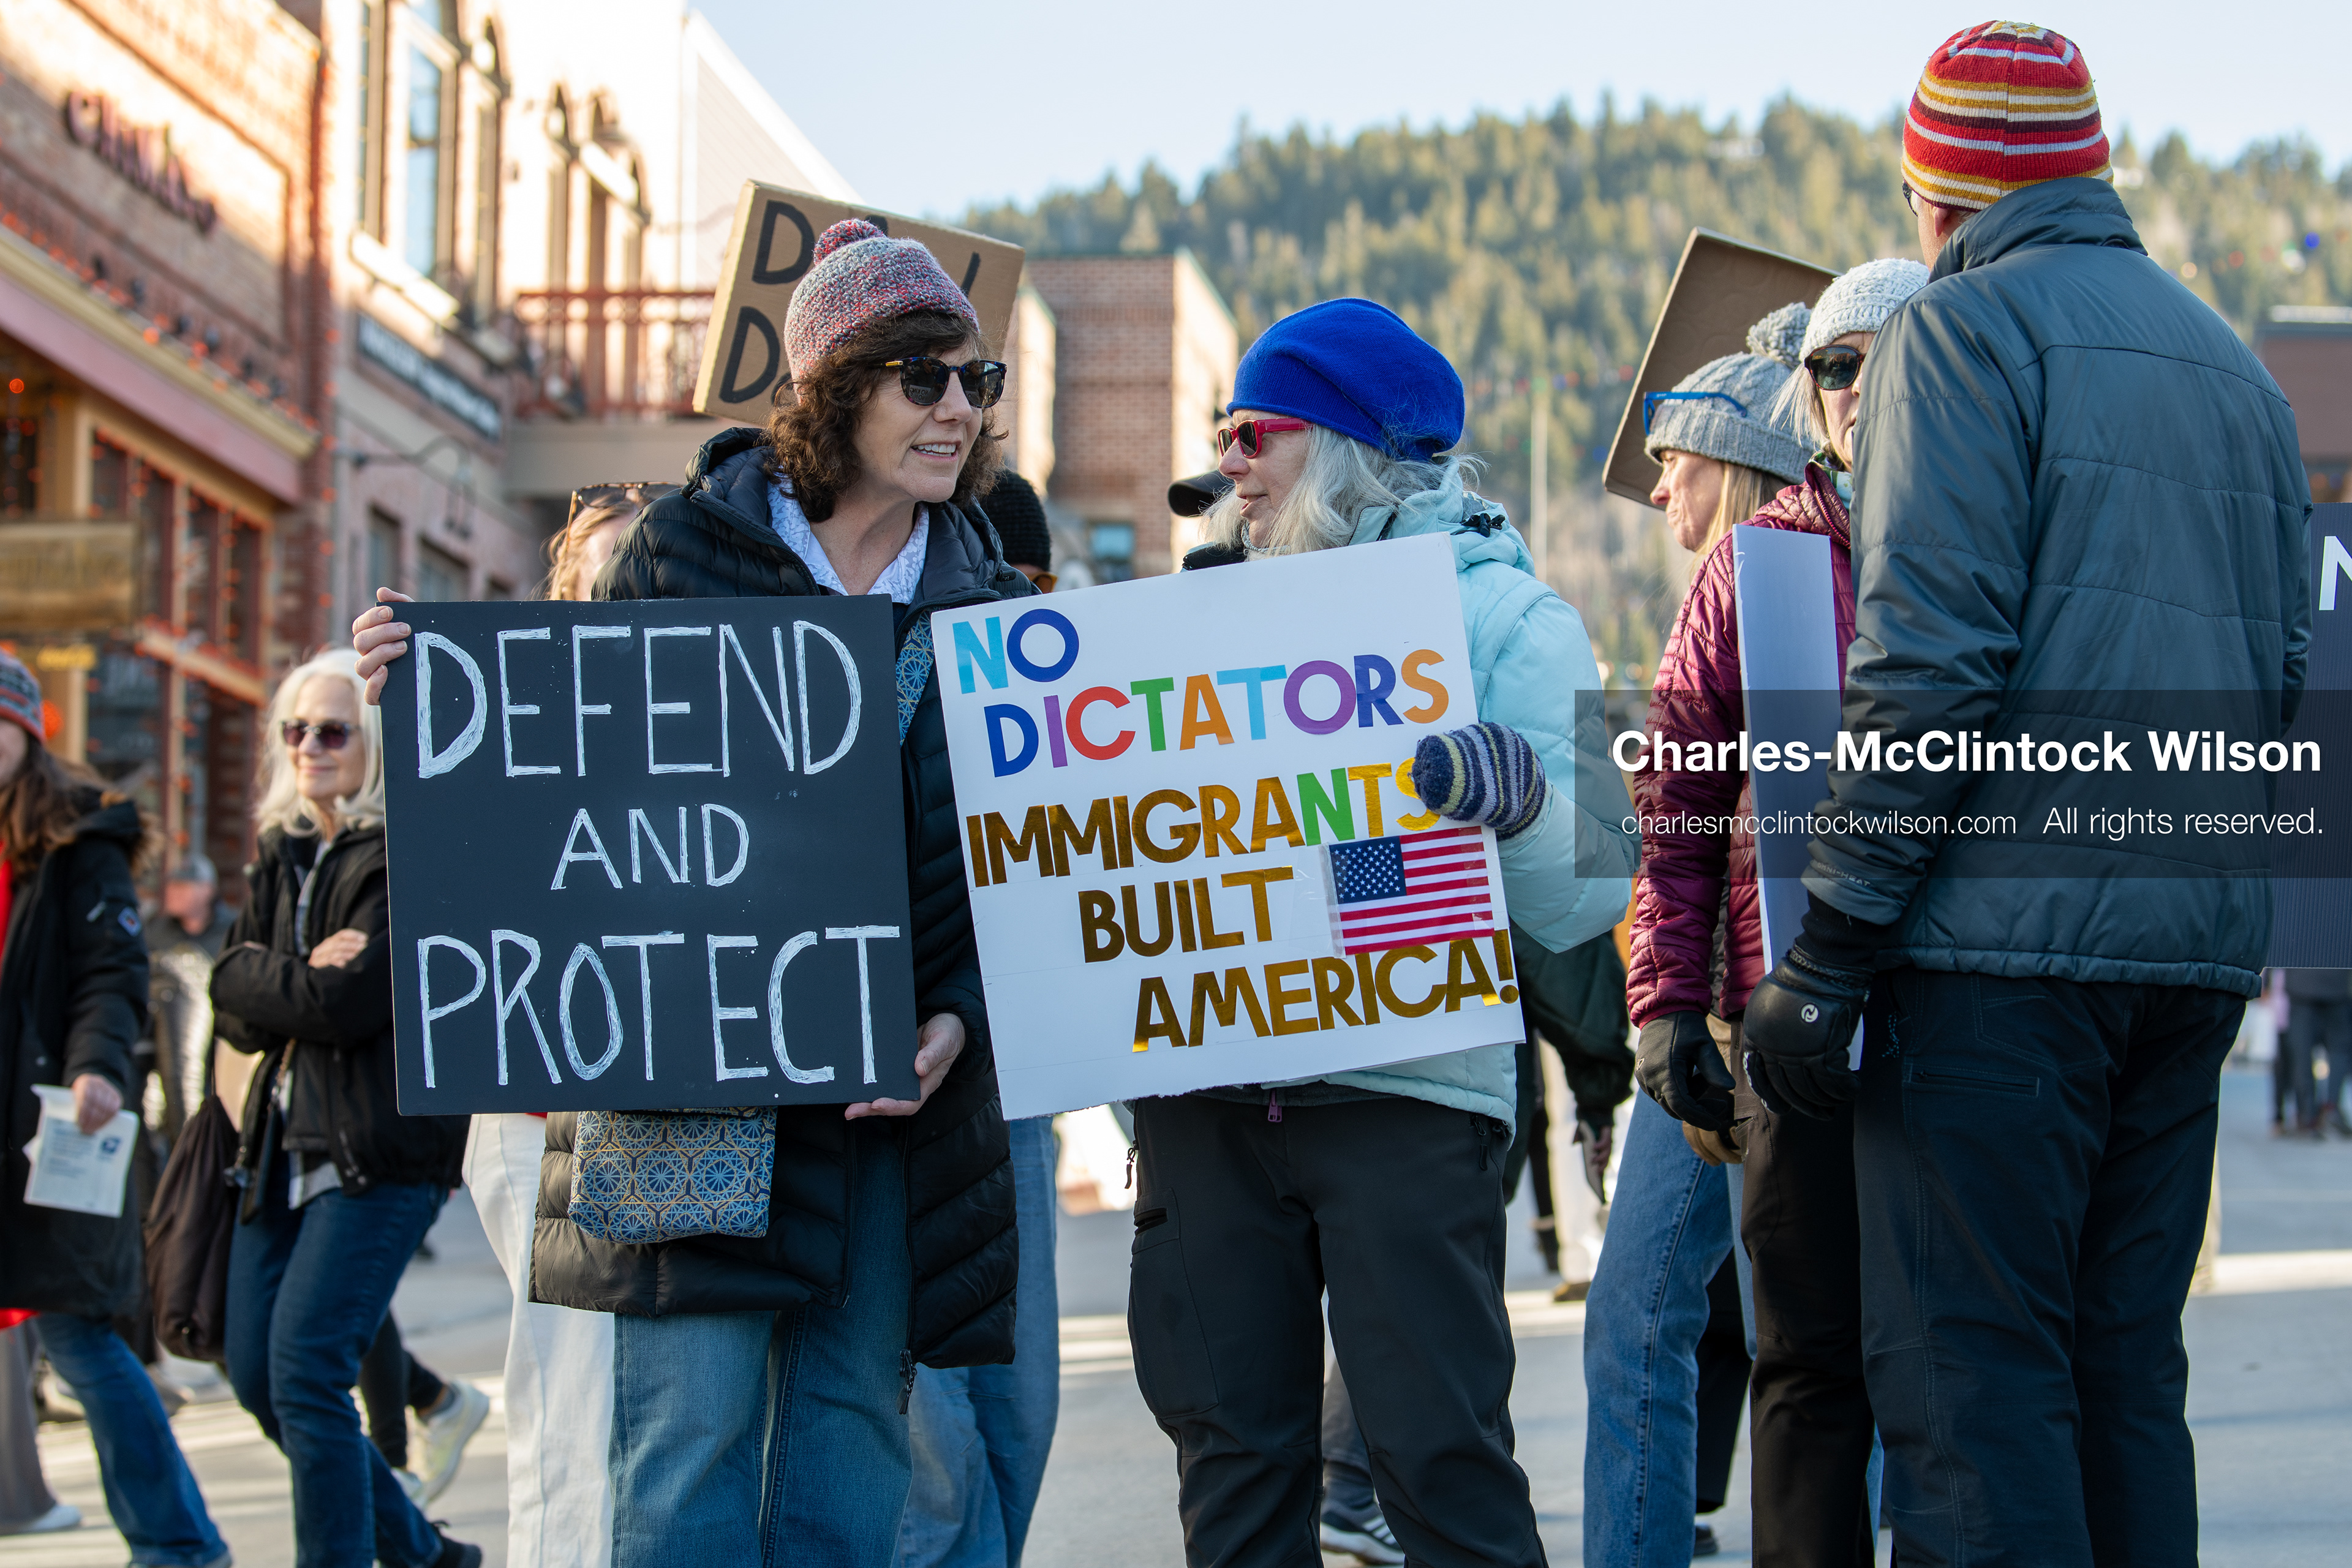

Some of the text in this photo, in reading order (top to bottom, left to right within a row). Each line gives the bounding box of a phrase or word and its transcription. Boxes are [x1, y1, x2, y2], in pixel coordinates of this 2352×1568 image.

[415, 620, 861, 778] DEFEND
[952, 608, 1079, 694] NO
[984, 649, 1449, 778] DICTATORS
[551, 804, 749, 891] AND
[1078, 865, 1294, 963] BUILT
[418, 925, 900, 1089] PROTECT
[1132, 929, 1519, 1053] AMERICA!
